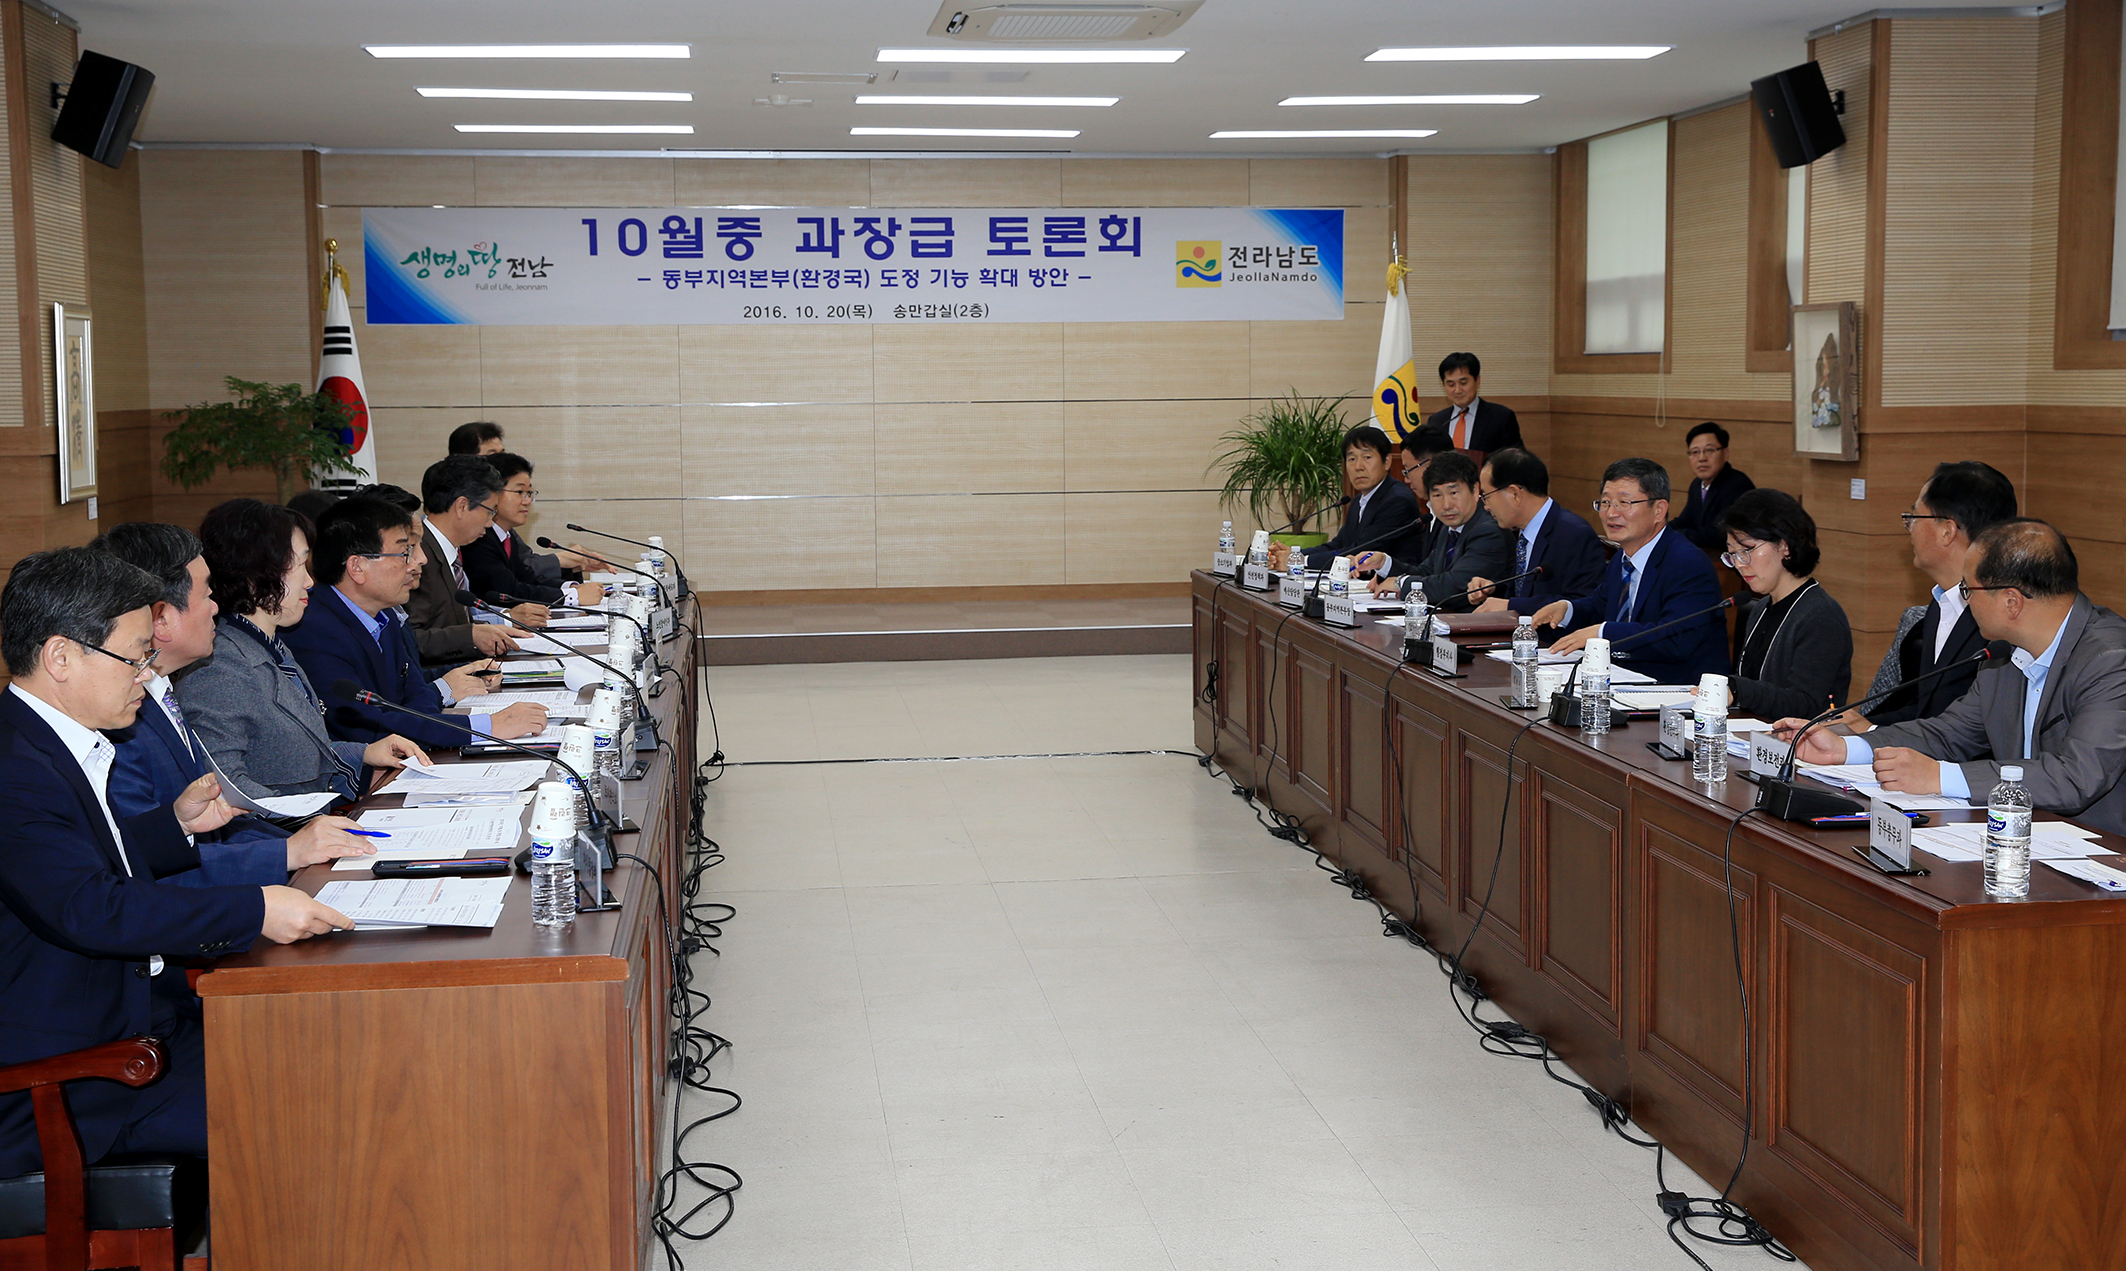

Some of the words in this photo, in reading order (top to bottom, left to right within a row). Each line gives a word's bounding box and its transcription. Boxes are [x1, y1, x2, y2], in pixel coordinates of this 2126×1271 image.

[582, 215, 762, 261] 10월중
[796, 216, 955, 261] 과장급
[986, 215, 1142, 258] 토론회
[400, 247, 470, 278] 생명의
[467, 242, 502, 278] 땅
[507, 256, 554, 278] 전남
[1228, 246, 1319, 269] 전라남도
[475, 283, 488, 291] Full
[490, 283, 498, 291] of
[499, 283, 514, 292] Life,
[515, 283, 548, 291] Jeonnam
[662, 268, 870, 289] 동부지역본부(환경국)
[879, 269, 920, 289] 도정
[930, 269, 970, 289] 기능
[978, 268, 1018, 288] 확대
[1028, 268, 1070, 288] 방안
[1229, 272, 1318, 282] JeollaNamdo
[743, 305, 787, 319] 2016.
[796, 305, 819, 319] 10.
[827, 304, 873, 320] 20(목)
[893, 303, 990, 319] 송만갑실(2층)
